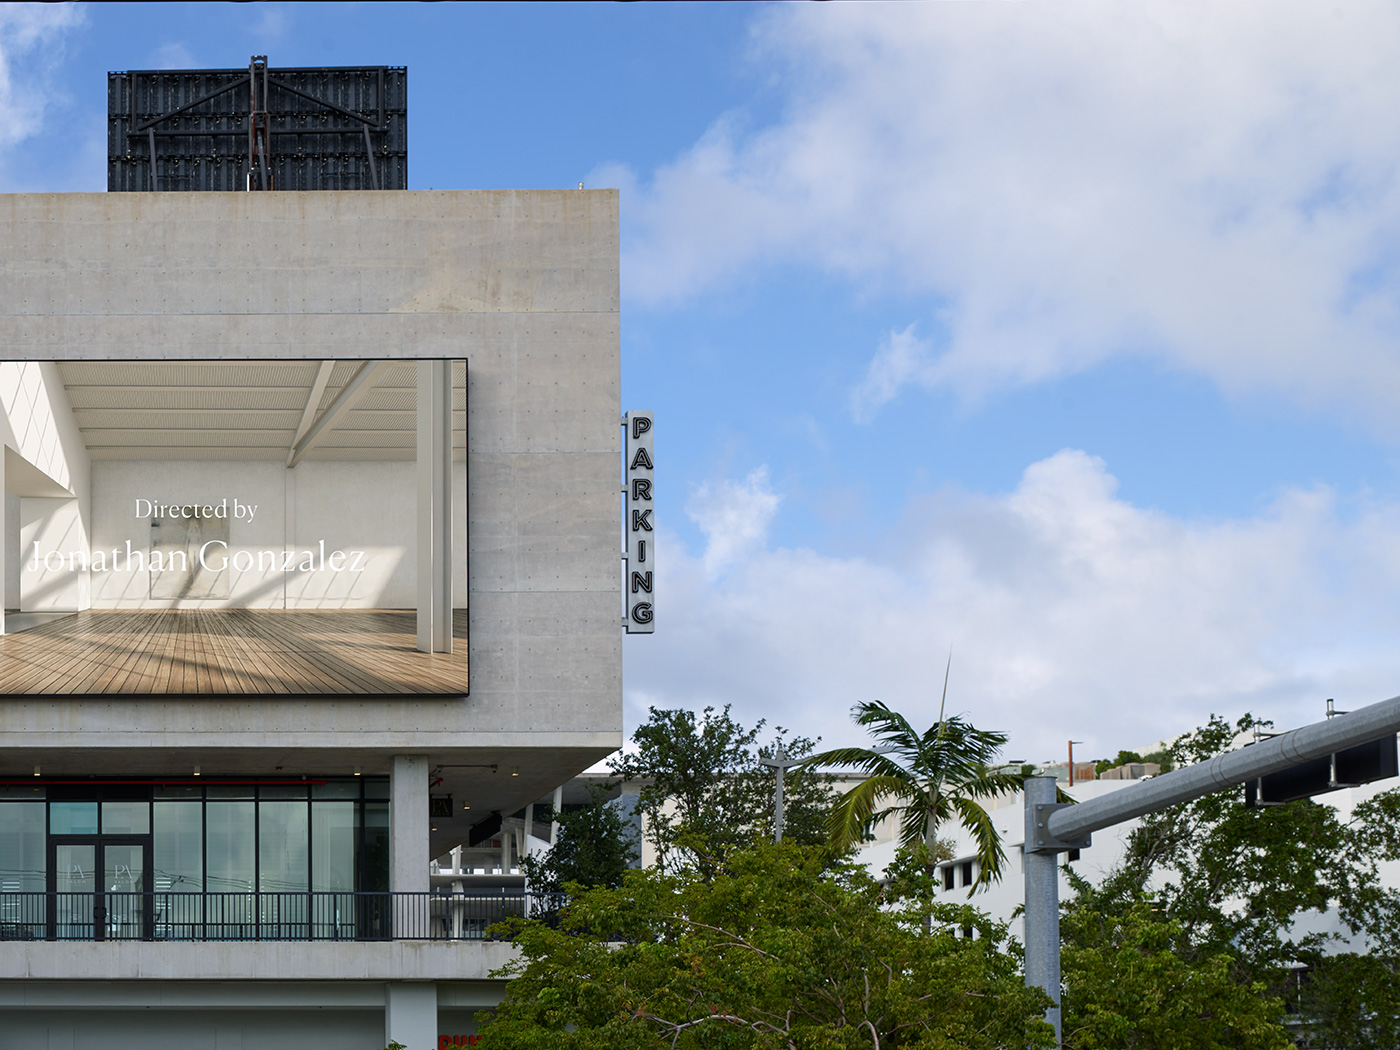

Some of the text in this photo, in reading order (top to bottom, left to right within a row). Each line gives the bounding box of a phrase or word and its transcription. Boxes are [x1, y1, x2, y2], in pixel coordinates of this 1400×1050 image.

[135, 499, 258, 523] Directed by
[630, 416, 654, 624] PARKING
[27, 540, 365, 572] Jonathan Gonzalez
